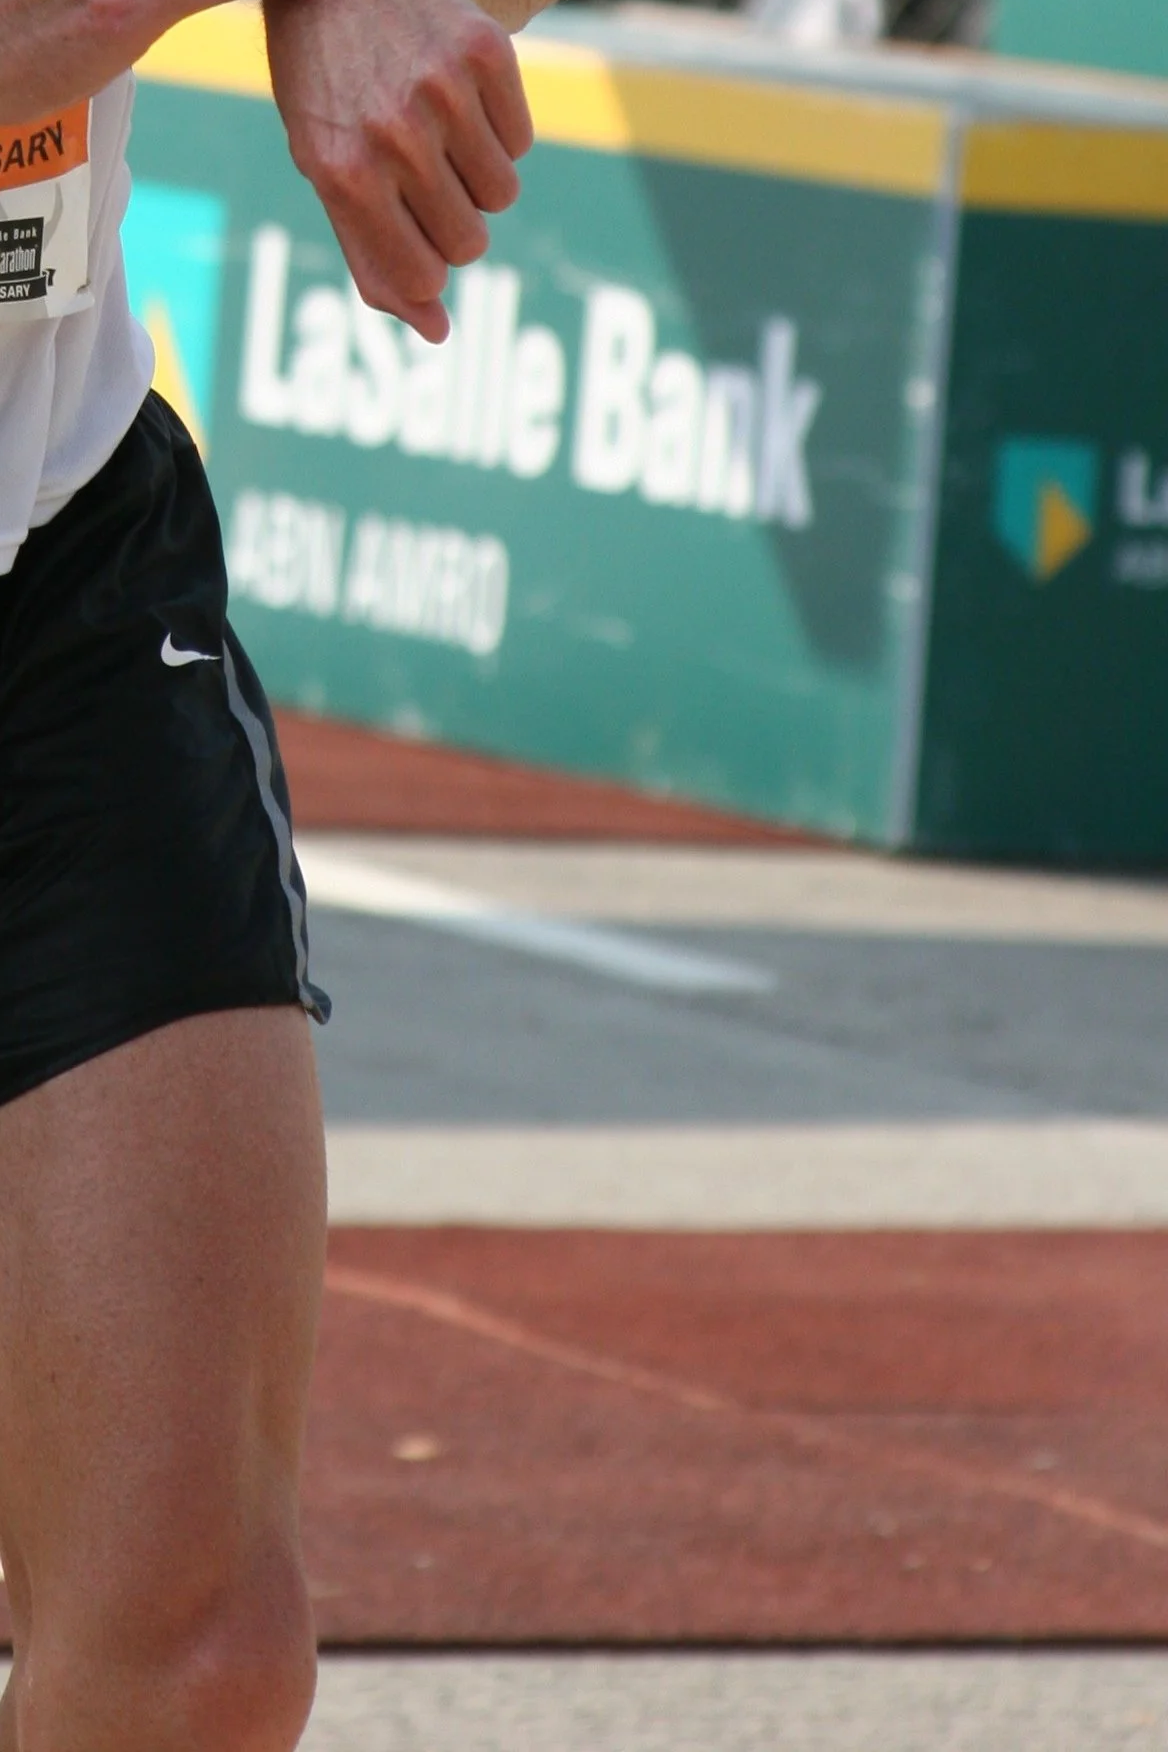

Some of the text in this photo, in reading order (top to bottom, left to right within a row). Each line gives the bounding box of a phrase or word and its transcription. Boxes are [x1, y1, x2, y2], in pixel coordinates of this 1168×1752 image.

[13, 227, 38, 240] Bank
[239, 223, 822, 531] LaSalle Bank
[225, 488, 510, 657] ABN AMRO
